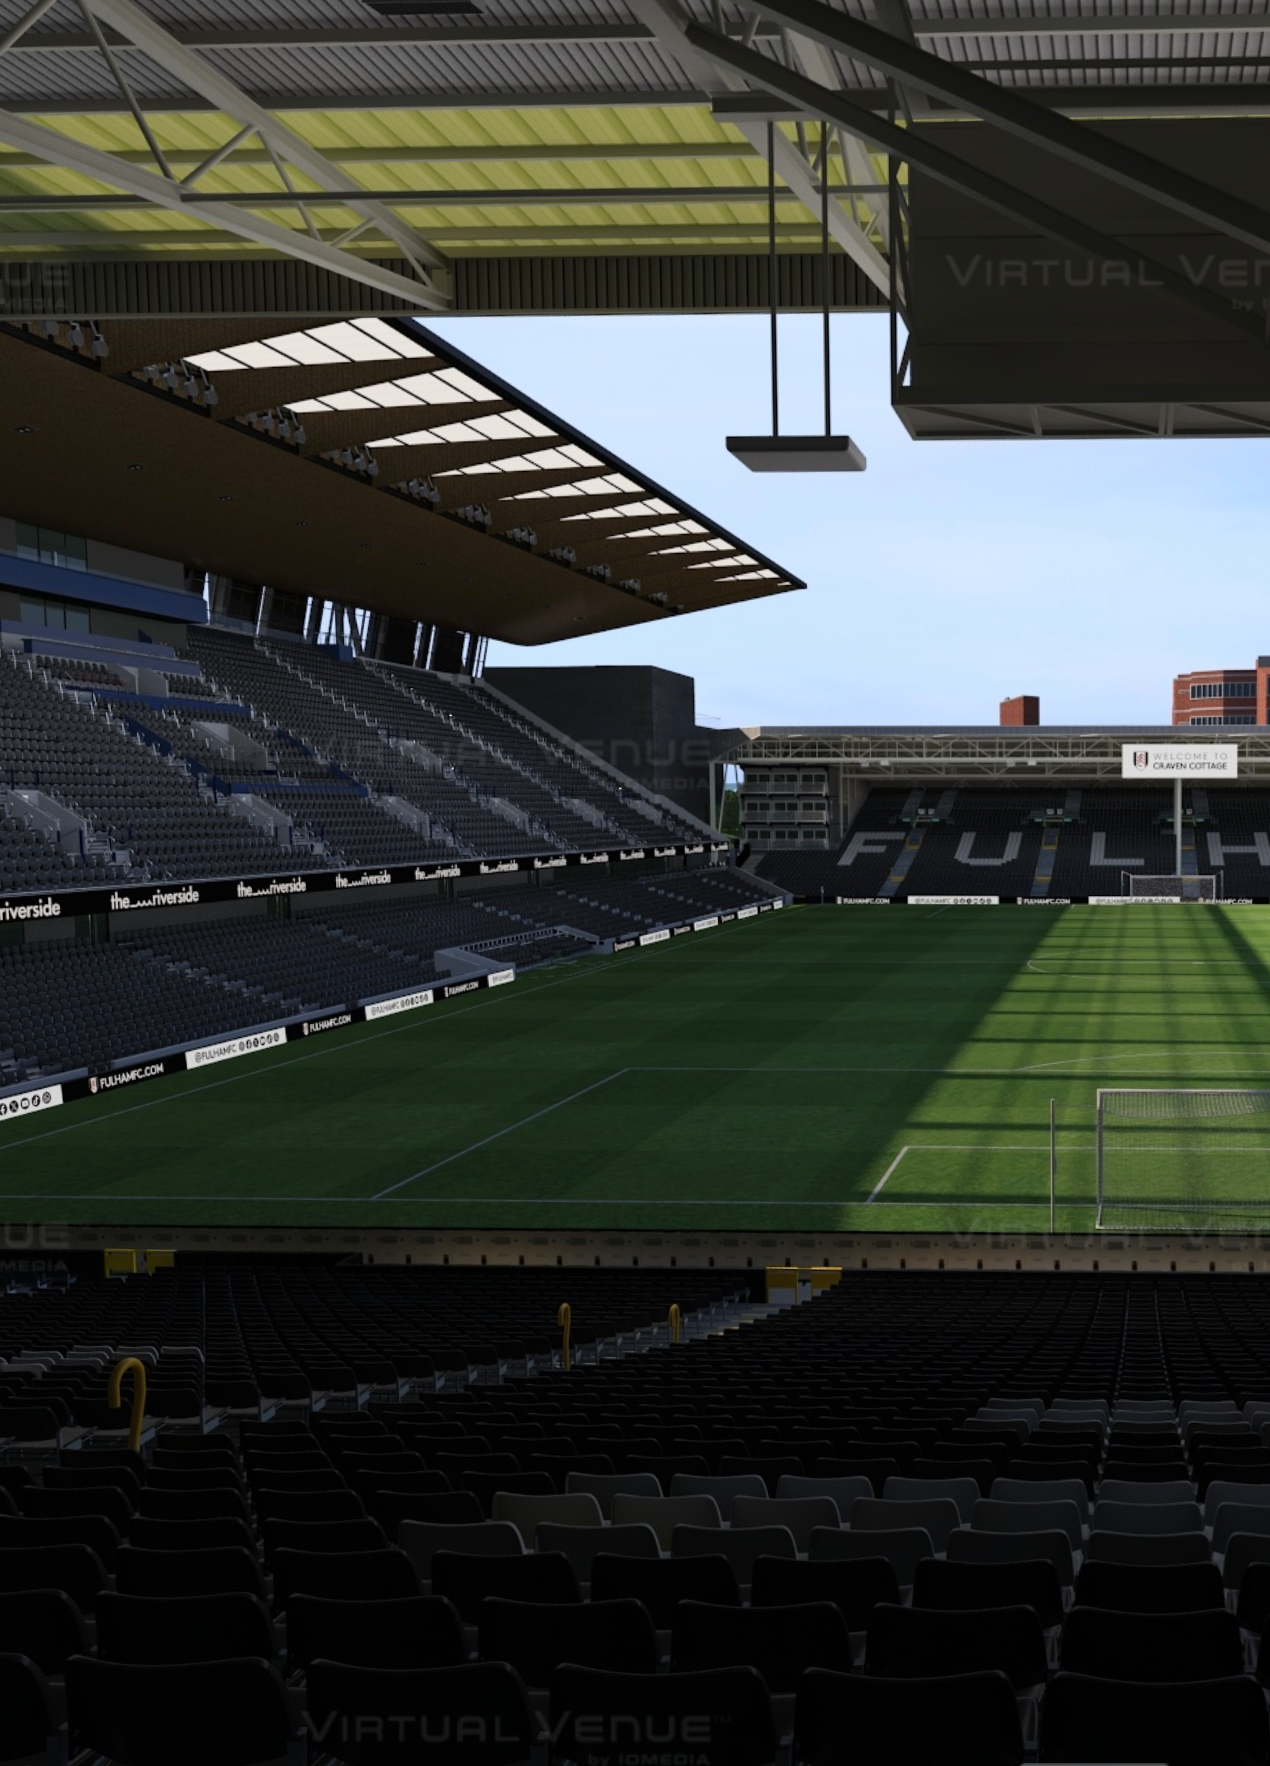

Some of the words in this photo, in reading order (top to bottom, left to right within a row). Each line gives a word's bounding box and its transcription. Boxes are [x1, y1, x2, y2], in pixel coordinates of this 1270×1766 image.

[1153, 752, 1207, 760] WELCOME
[1214, 752, 1228, 760] TO
[1153, 762, 1187, 770] CRAVEN
[1189, 762, 1228, 770] COTTAGE
[237, 881, 253, 897] the
[269, 877, 306, 894] riverside
[110, 891, 130, 910] the
[152, 886, 199, 906] riverside
[0, 897, 61, 921] riverside
[309, 1013, 351, 1032] FULHAMFC.COM
[194, 1043, 237, 1063] @FULHAMFC
[100, 1063, 164, 1089] FULHAMFC.COM
